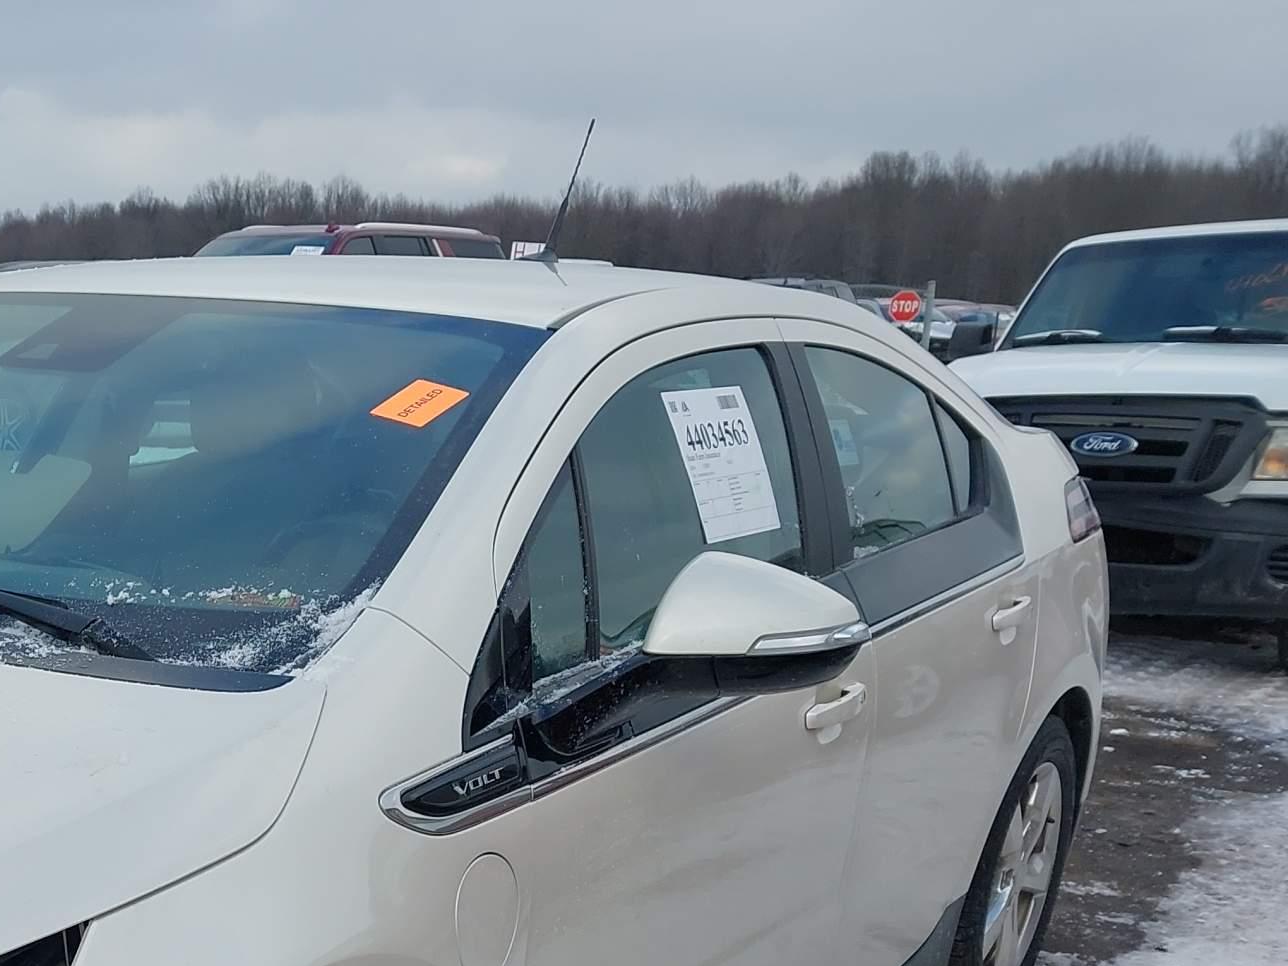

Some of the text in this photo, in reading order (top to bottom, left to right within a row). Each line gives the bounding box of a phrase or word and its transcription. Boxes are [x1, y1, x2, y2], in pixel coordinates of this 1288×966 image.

[892, 300, 919, 313] STOP
[397, 388, 444, 418] DETAILED
[686, 418, 749, 451] 44034563
[1083, 436, 1123, 450] Ford
[453, 767, 505, 795] VOLT
